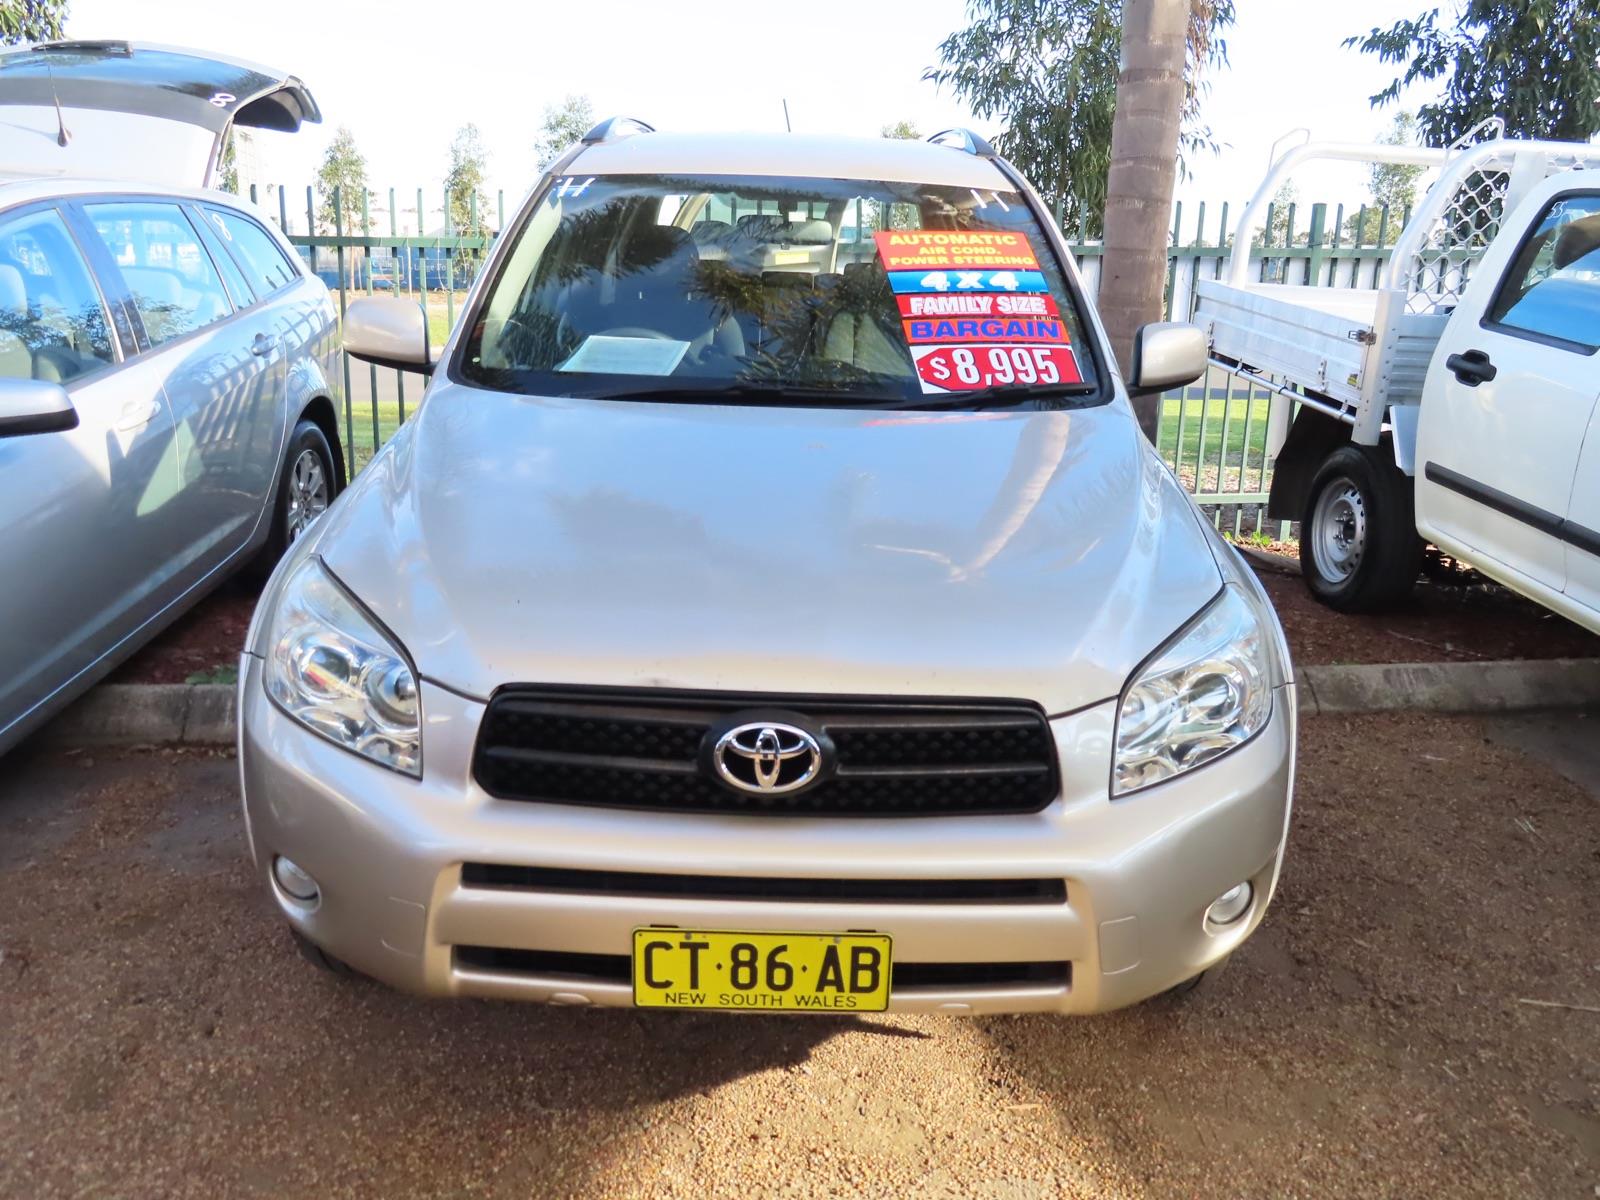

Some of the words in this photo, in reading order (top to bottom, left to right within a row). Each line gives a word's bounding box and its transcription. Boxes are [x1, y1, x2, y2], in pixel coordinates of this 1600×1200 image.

[889, 233, 1018, 246] AUTOMATIC
[919, 246, 947, 255] AIR
[950, 246, 1002, 255] COND.
[889, 256, 949, 266] POWER
[953, 256, 1035, 265] STEERING
[909, 296, 995, 314] FAMILY
[997, 296, 1048, 314] SIZE
[910, 320, 1060, 340] BARGAIN
[929, 348, 1061, 386] $8,995
[665, 992, 706, 1005] NEW
[719, 993, 783, 1007] SOUTH
[794, 994, 857, 1008] WALES
